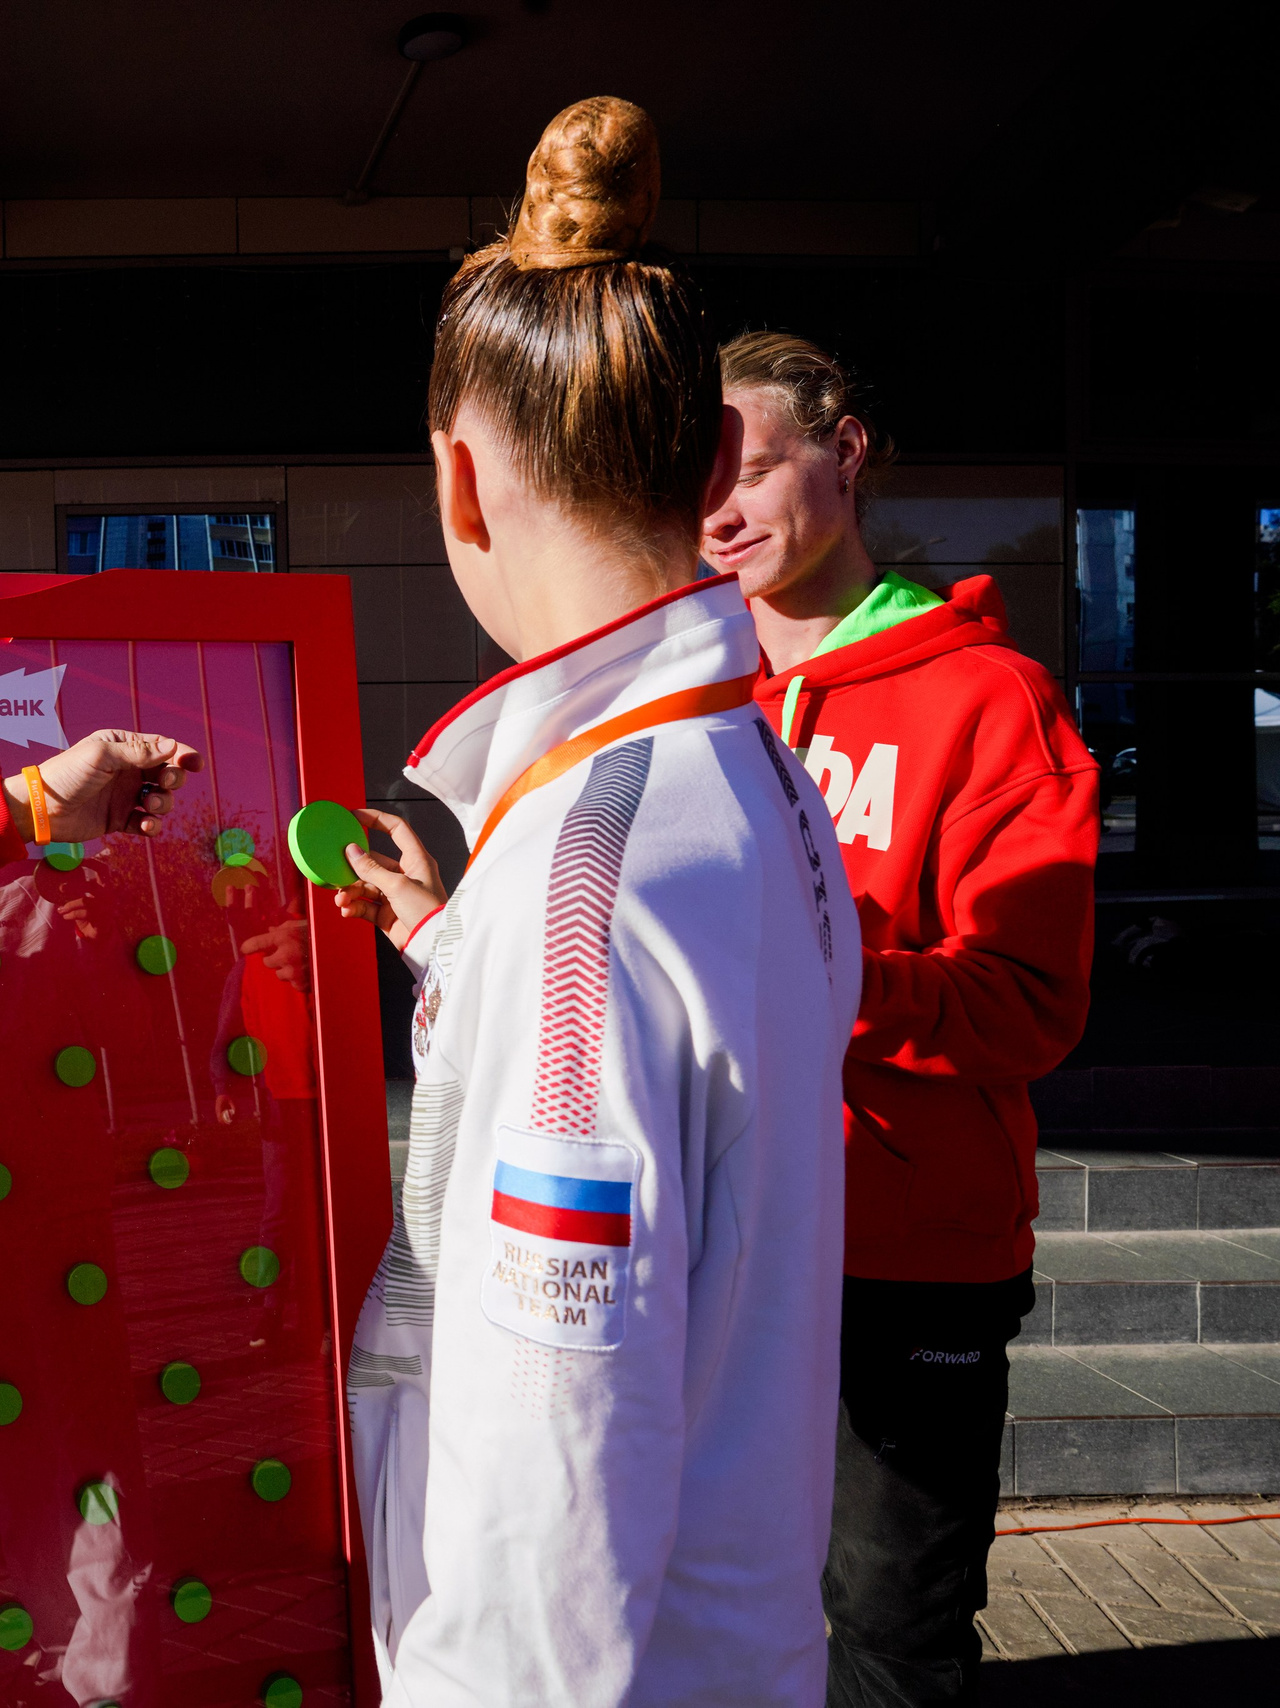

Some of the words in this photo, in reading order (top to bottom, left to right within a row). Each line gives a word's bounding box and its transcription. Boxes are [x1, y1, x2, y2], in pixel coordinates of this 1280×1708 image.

[504, 1240, 608, 1281] RUSSIAN
[492, 1261, 616, 1305] NATIONAL
[513, 1290, 587, 1326] TEAM
[909, 1343, 981, 1365] FORWARD
